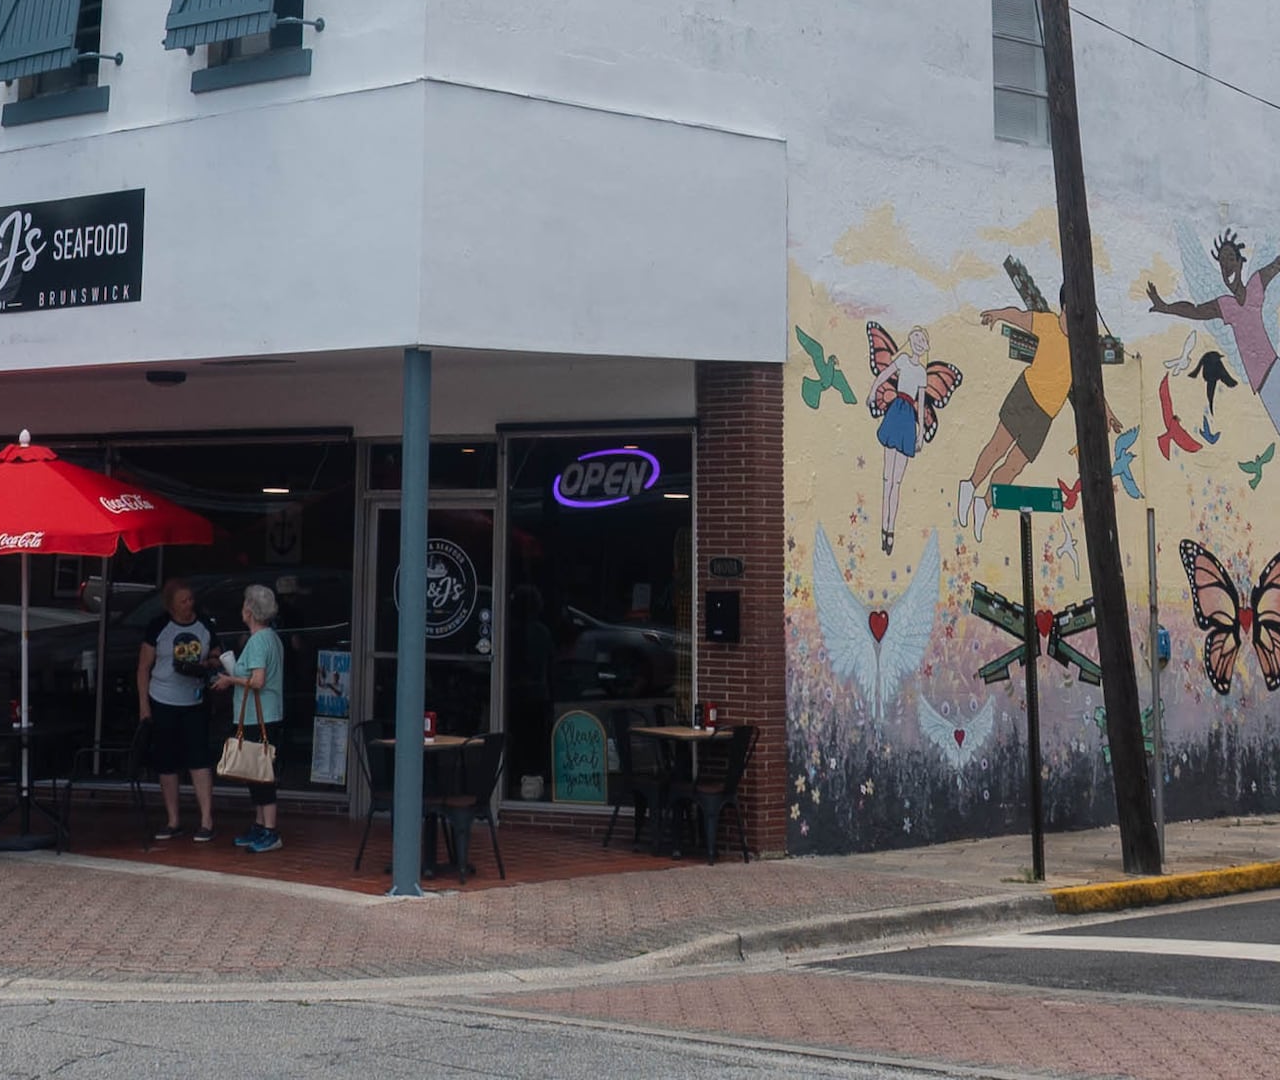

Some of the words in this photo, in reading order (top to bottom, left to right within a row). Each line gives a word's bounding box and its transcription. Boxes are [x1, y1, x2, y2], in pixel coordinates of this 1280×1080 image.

[53, 222, 128, 261] SEAFOOD
[38, 284, 130, 308] BRUNSWICK
[560, 461, 648, 496] OPEN
[427, 576, 466, 608] &J's
